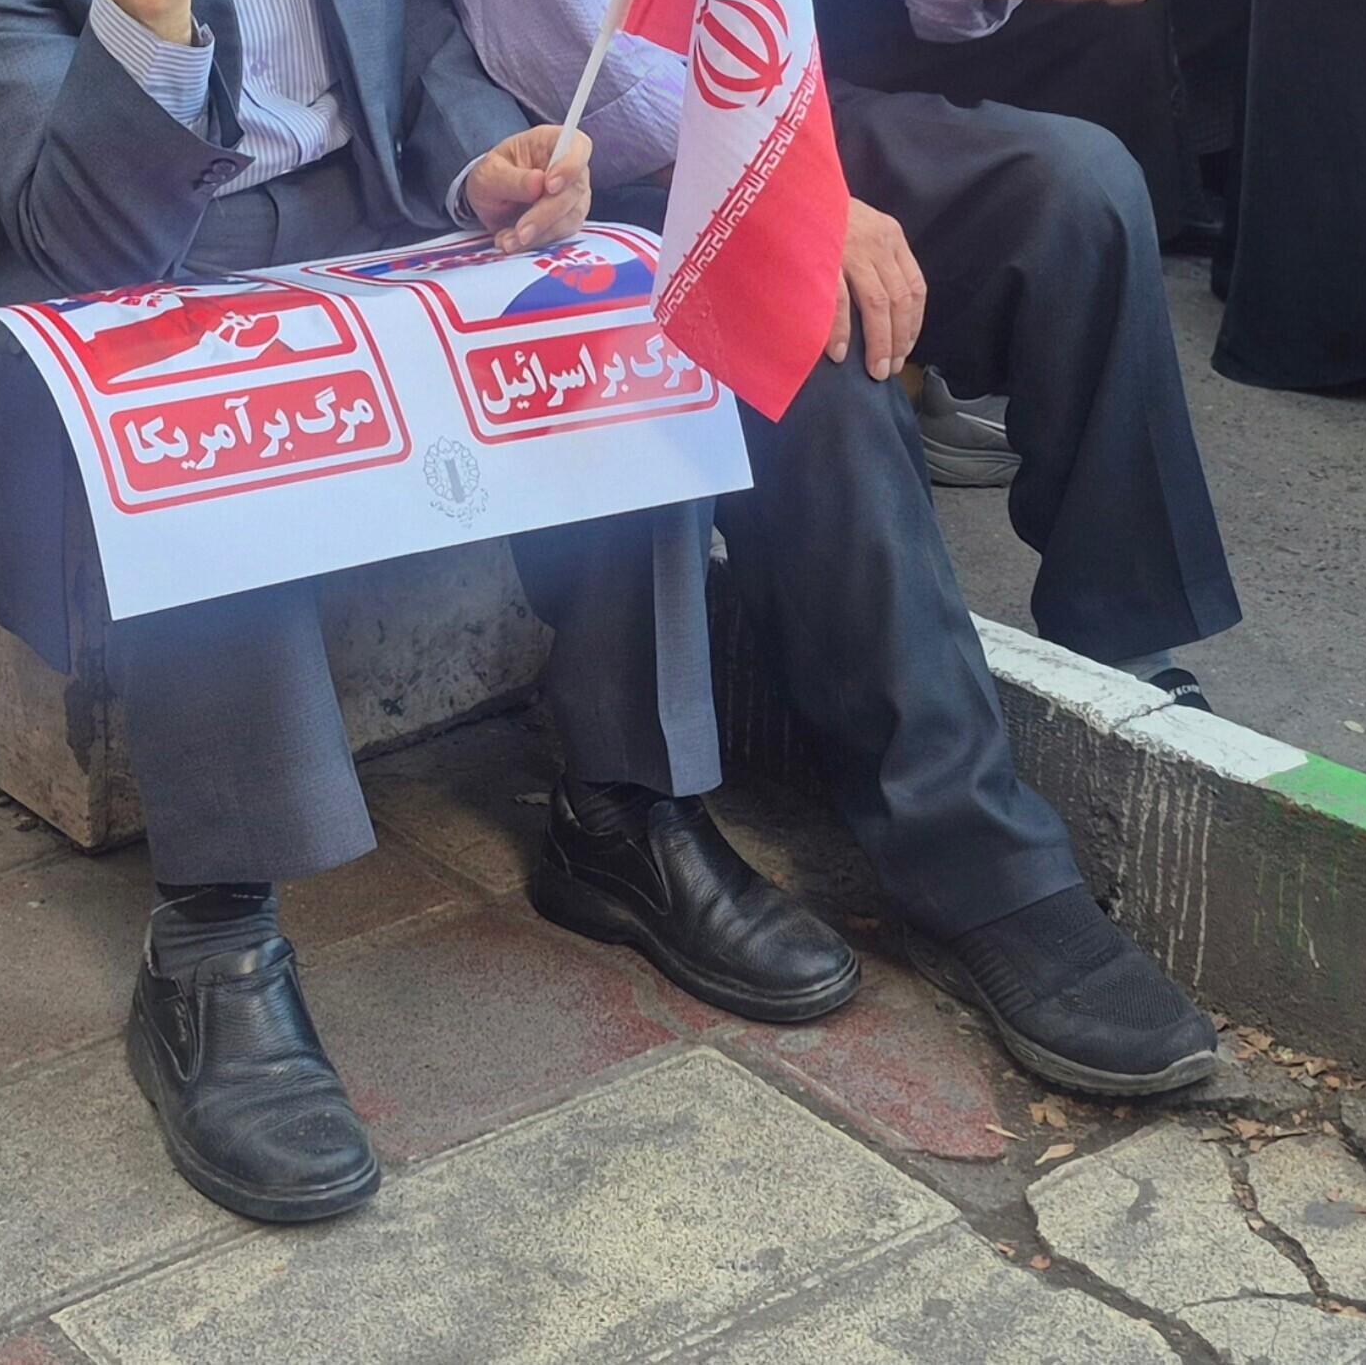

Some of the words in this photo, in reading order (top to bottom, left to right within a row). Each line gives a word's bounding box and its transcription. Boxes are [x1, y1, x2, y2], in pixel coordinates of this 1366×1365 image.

[481, 343, 597, 415] اسرائیل
[600, 351, 630, 398] بر
[629, 333, 696, 389] مرگ
[123, 395, 253, 471] آمریکا
[259, 407, 294, 459] بر
[294, 386, 375, 445] مرگ
